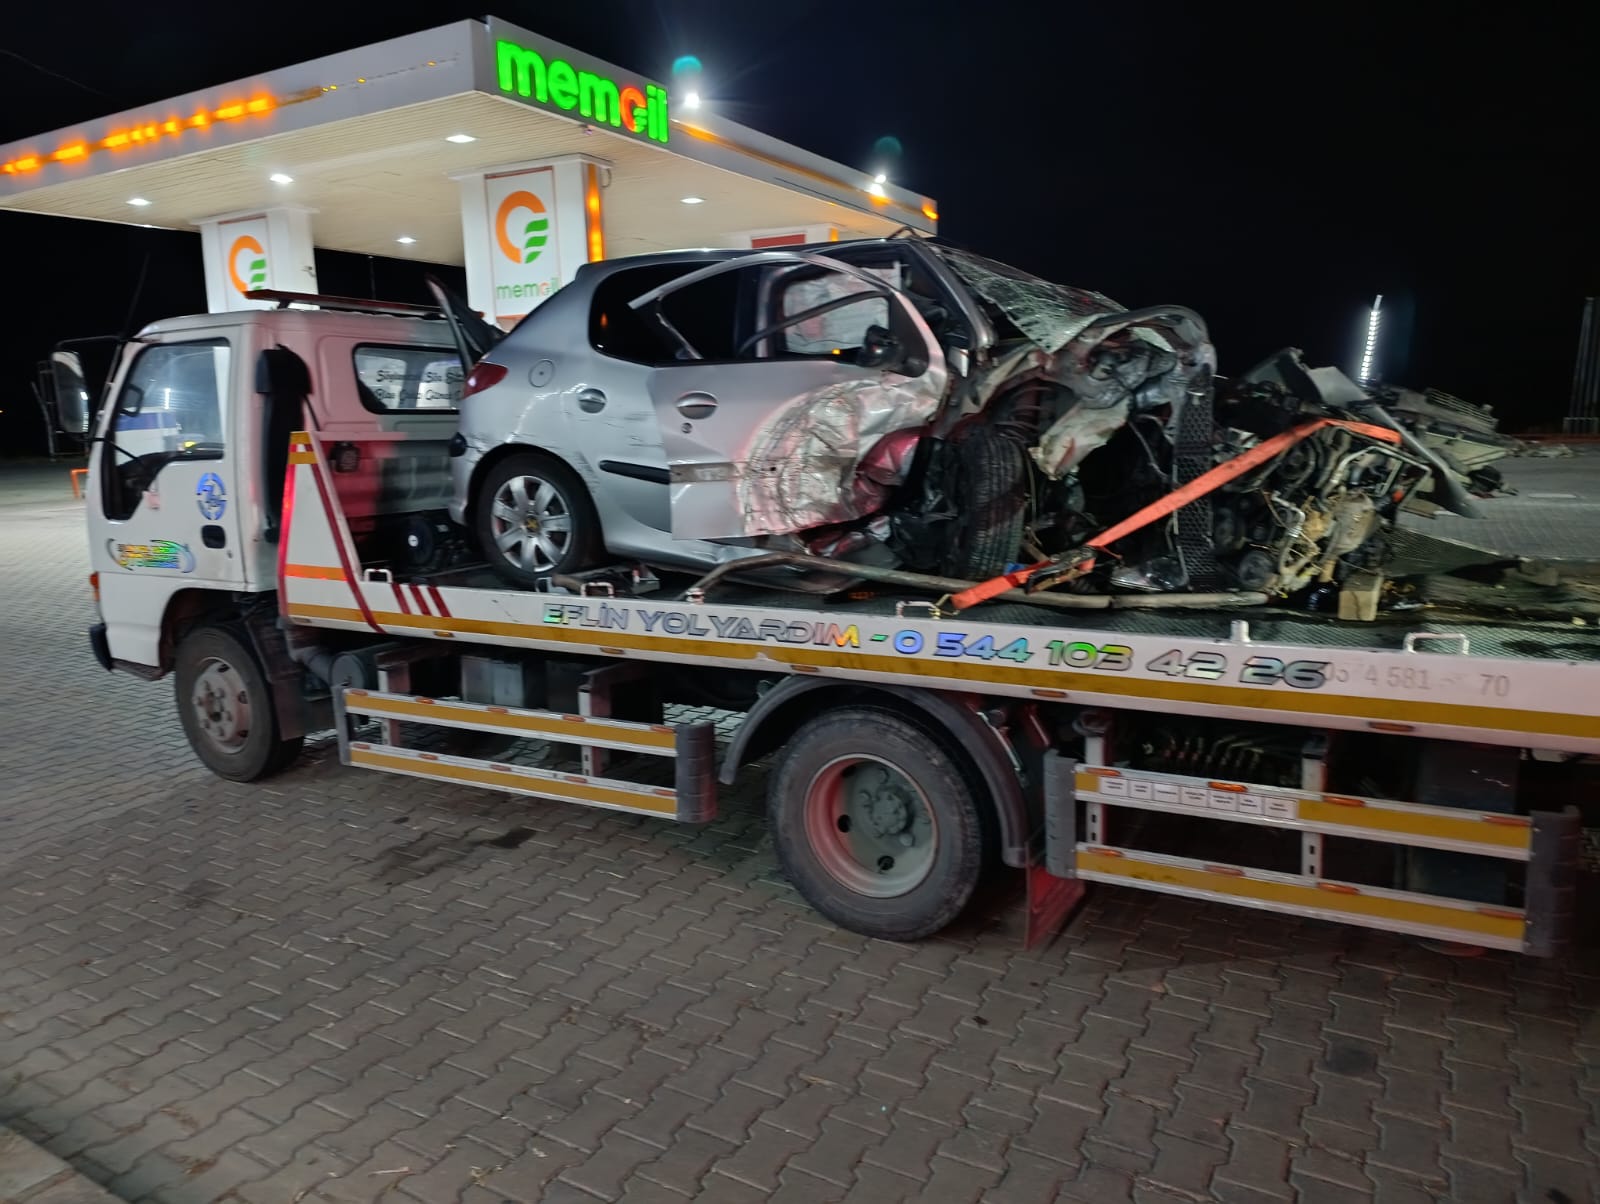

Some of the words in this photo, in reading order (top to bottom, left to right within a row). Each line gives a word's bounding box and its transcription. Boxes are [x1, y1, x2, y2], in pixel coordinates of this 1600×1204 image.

[497, 40, 668, 143] memoil
[543, 602, 629, 630] EFLİN
[894, 629, 924, 654] 0
[934, 632, 1034, 663] 544
[1045, 640, 1134, 671] 103
[1146, 649, 1228, 681] 42
[1238, 655, 1332, 689] 26
[1480, 673, 1510, 697] 70
